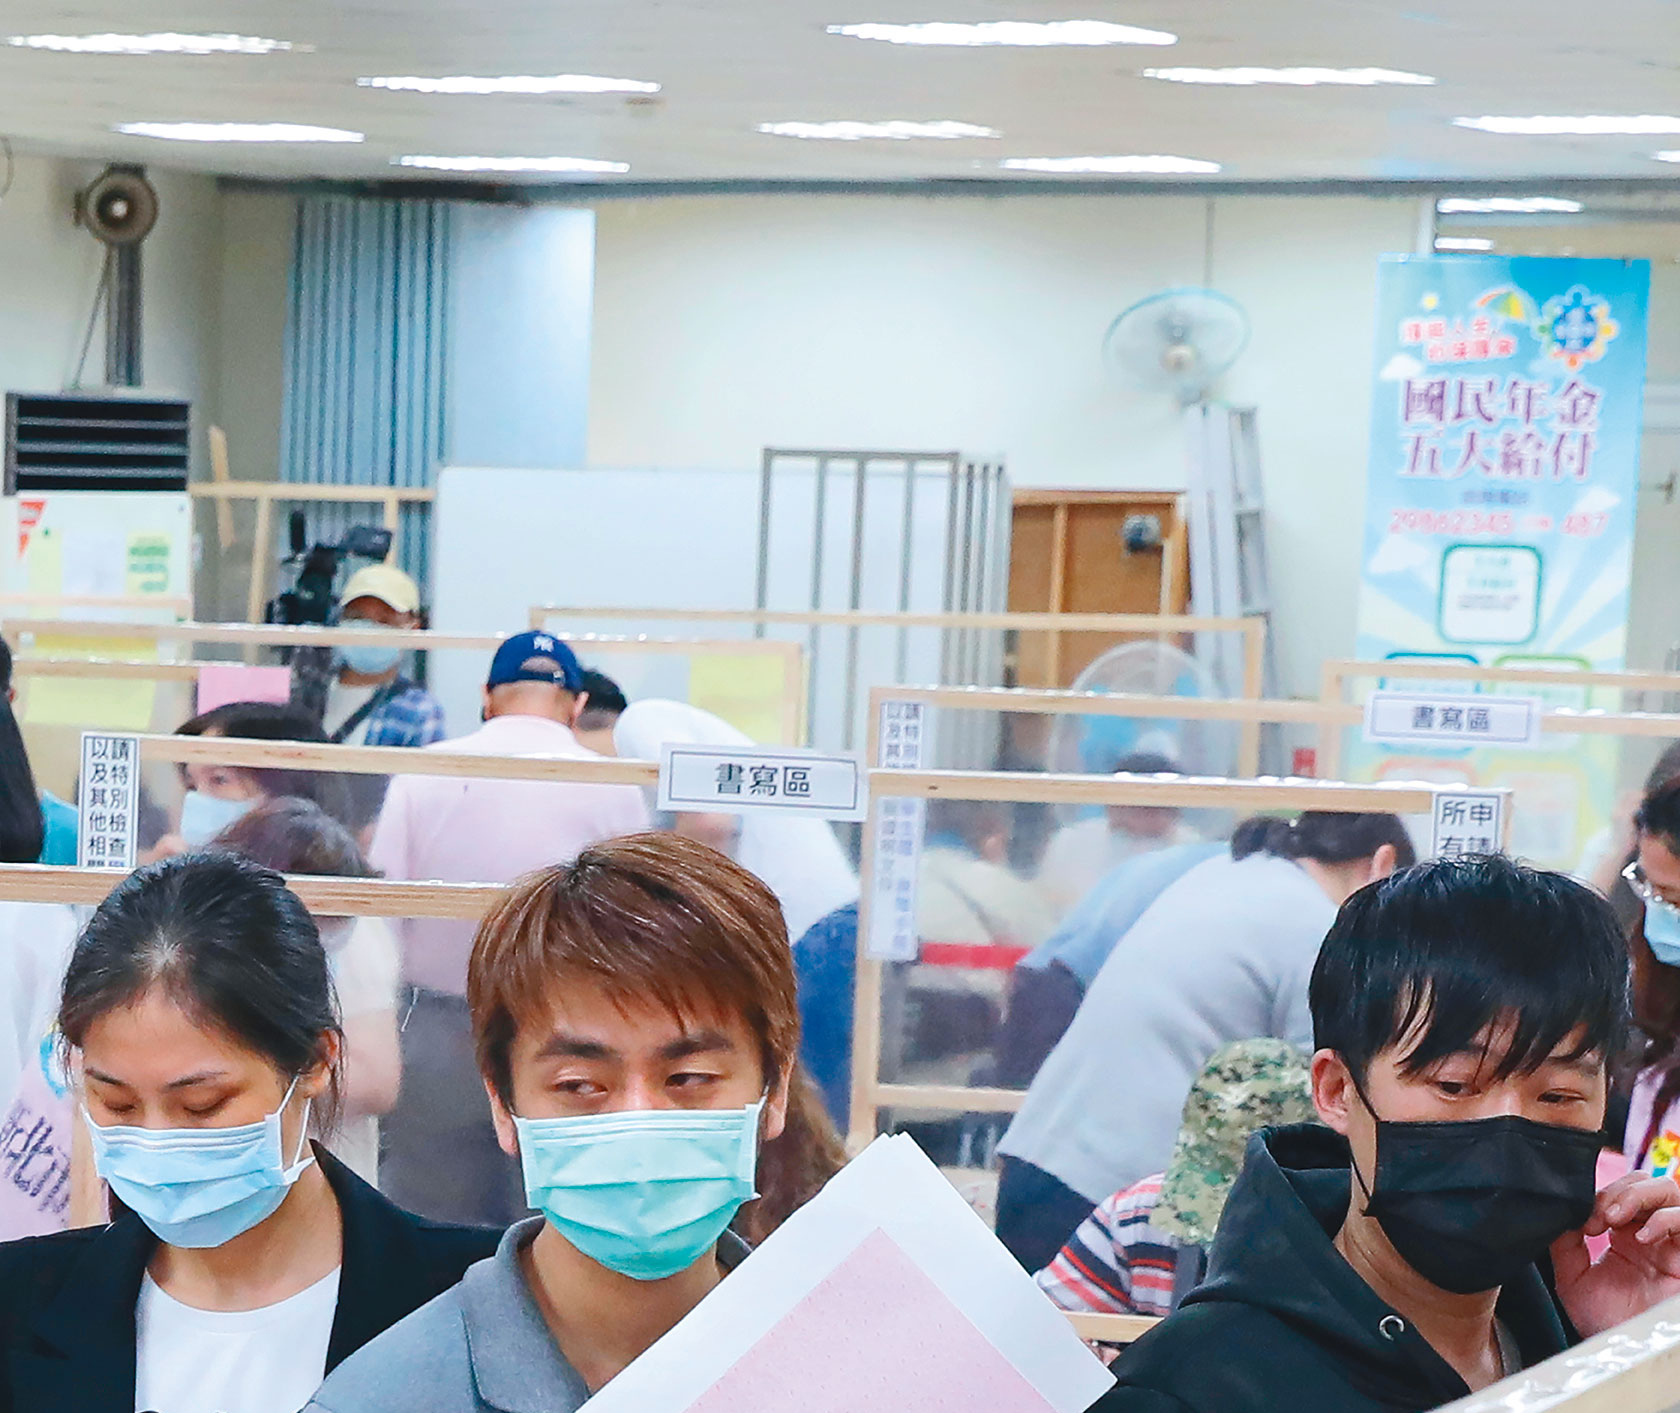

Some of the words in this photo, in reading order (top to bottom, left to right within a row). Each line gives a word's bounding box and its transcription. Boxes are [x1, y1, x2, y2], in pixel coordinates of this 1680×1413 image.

[1402, 377, 1601, 426] 國民年金
[1399, 429, 1598, 479] 五大給付
[1412, 706, 1490, 732] 書寫區
[715, 763, 811, 797] 書寫區
